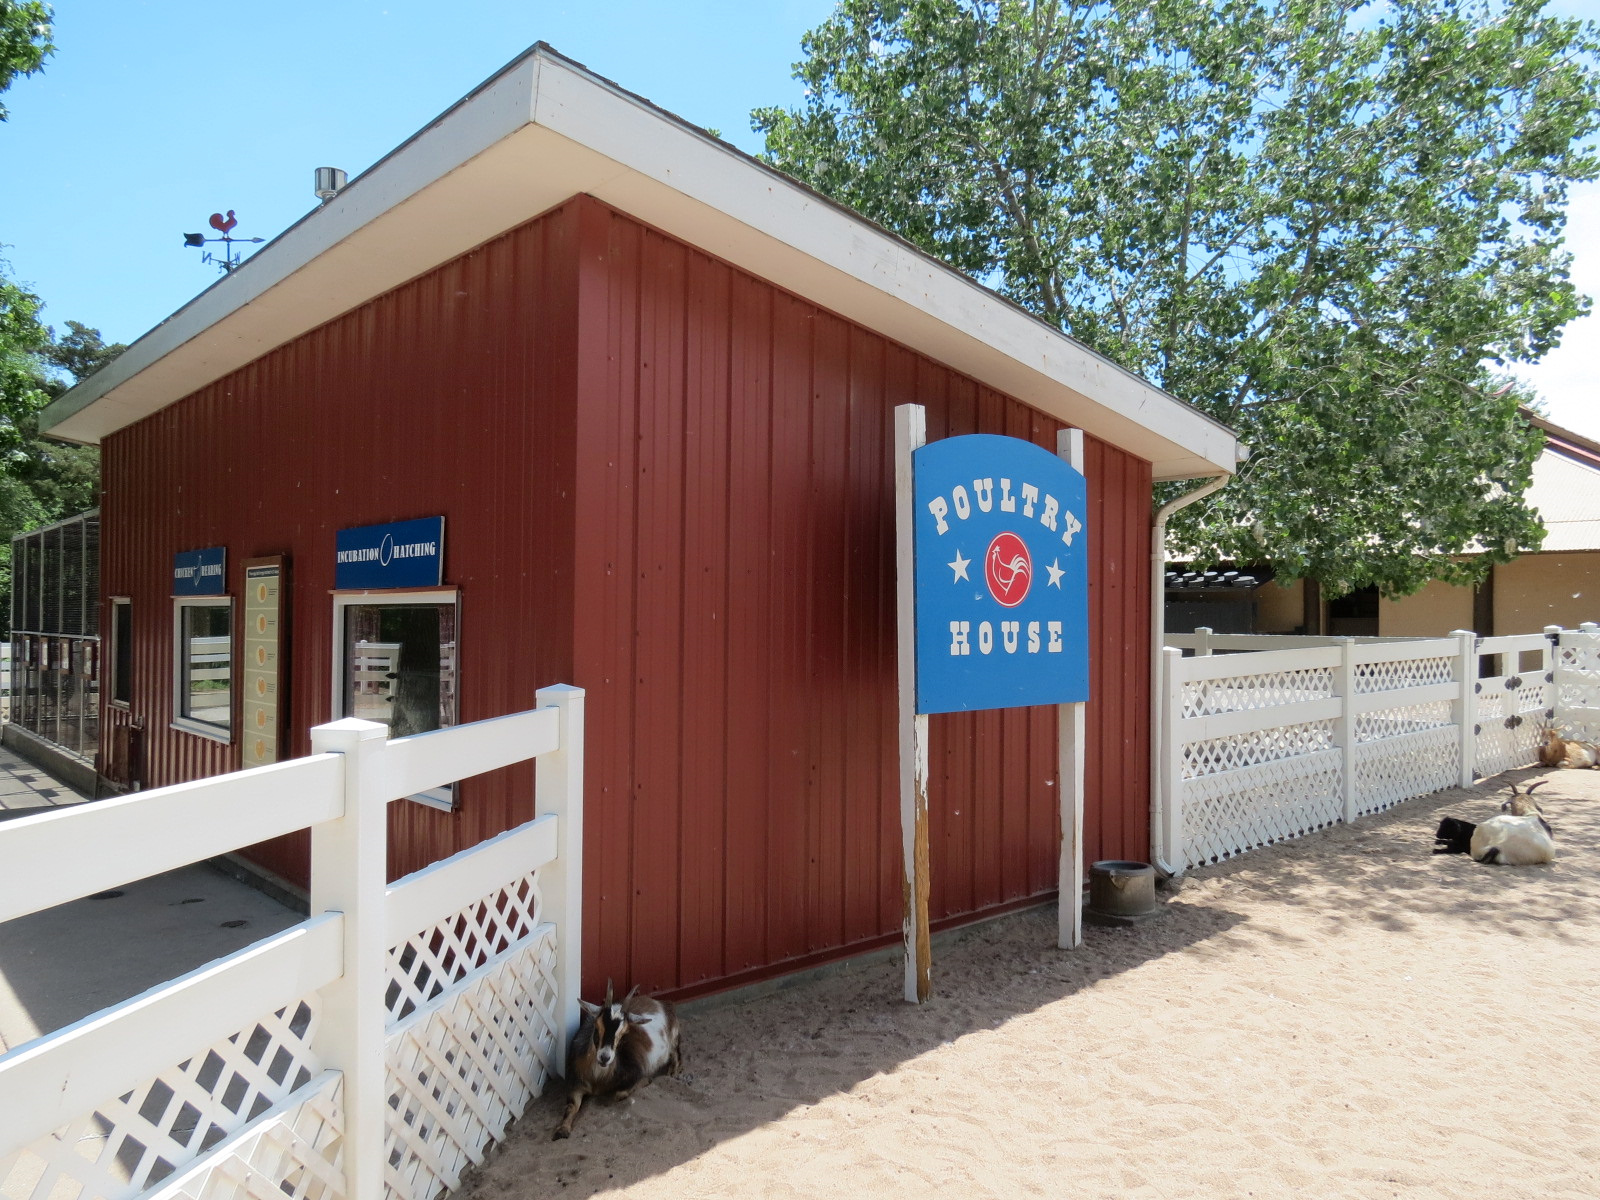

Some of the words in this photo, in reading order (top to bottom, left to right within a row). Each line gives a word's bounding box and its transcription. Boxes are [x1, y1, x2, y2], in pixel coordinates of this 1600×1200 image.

[928, 477, 1082, 547] POULTRY
[337, 547, 379, 563] INCUBATION
[393, 541, 436, 559] HATCHING
[201, 563, 222, 577] REARING
[949, 620, 1063, 656] HOUSE
